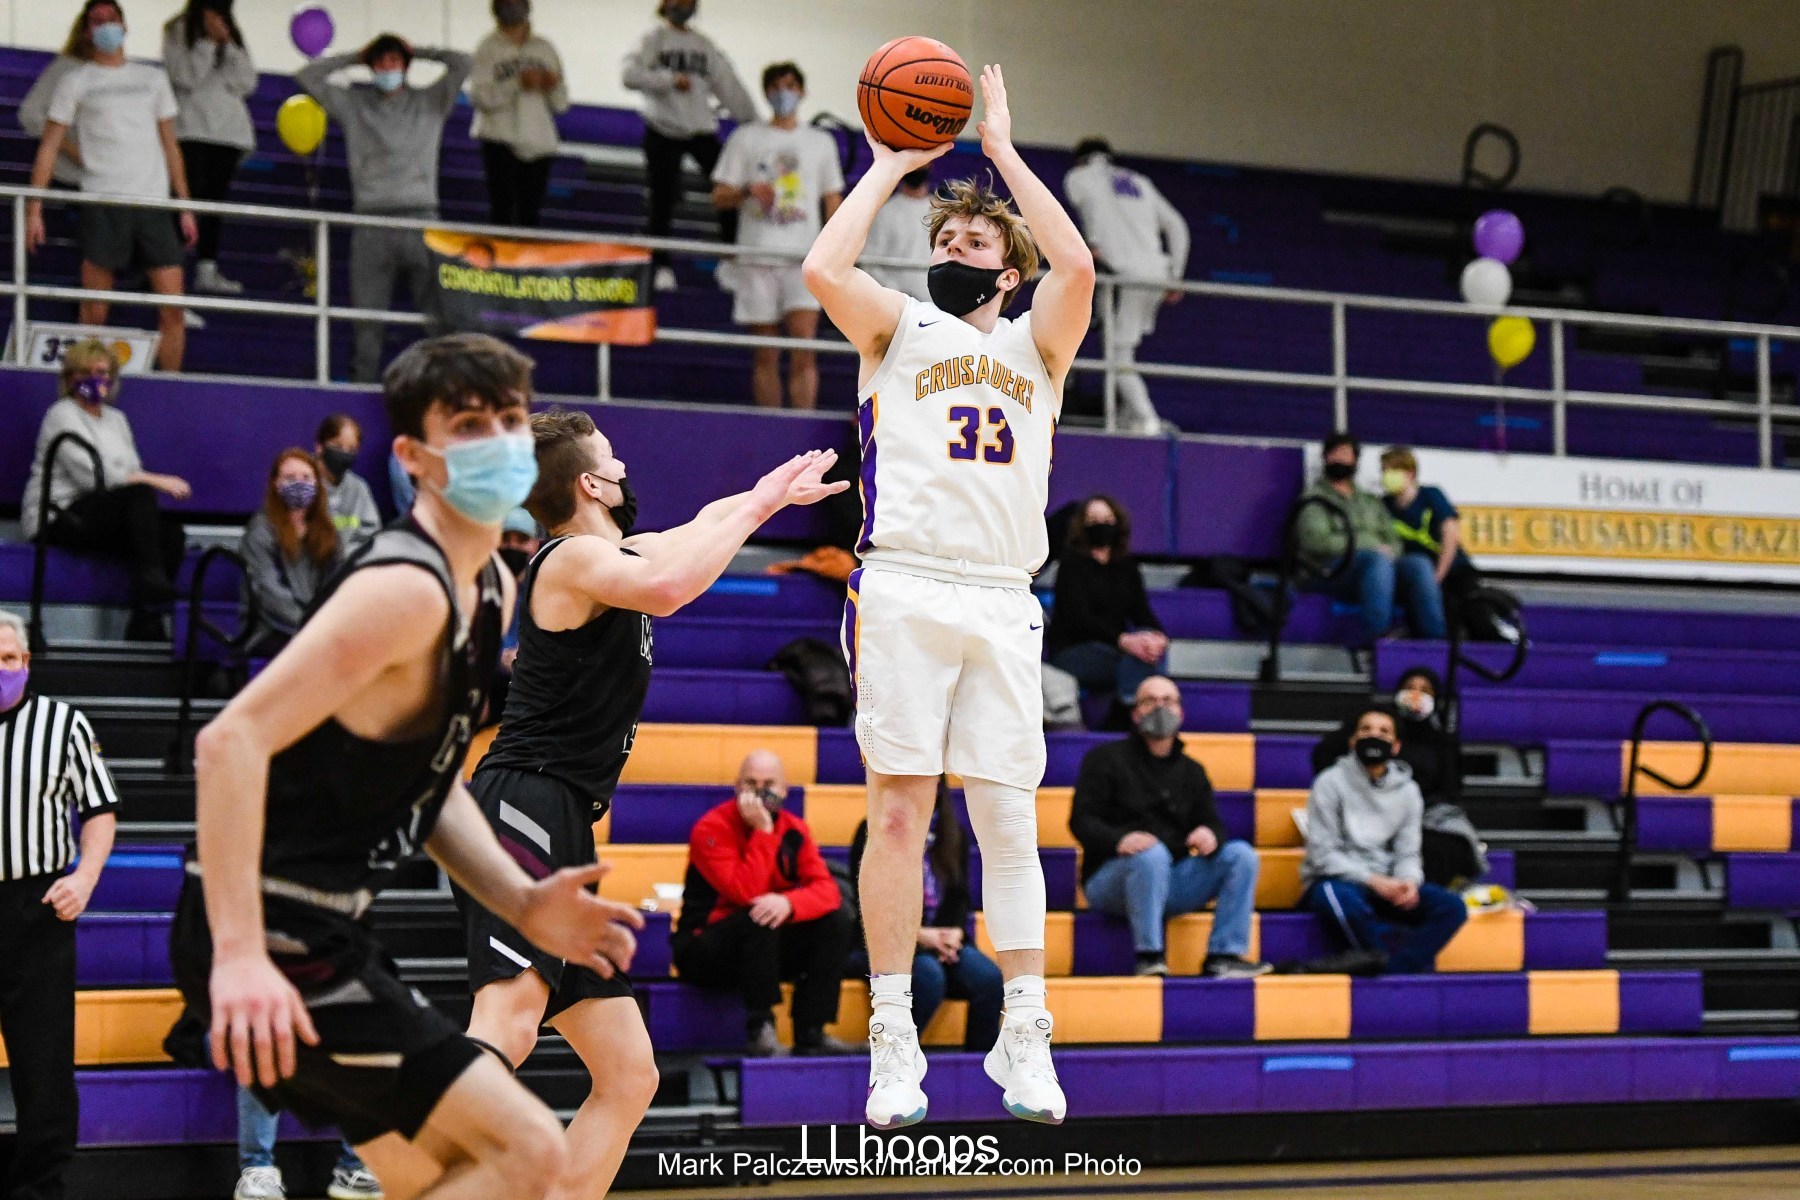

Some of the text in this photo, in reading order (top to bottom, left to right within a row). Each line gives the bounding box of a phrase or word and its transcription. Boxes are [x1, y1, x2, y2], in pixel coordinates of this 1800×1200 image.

[916, 355, 1034, 414] CRUSADERS
[947, 404, 1015, 466] 33
[1462, 512, 1513, 546] HE
[1523, 513, 1697, 553] CRUSADER
